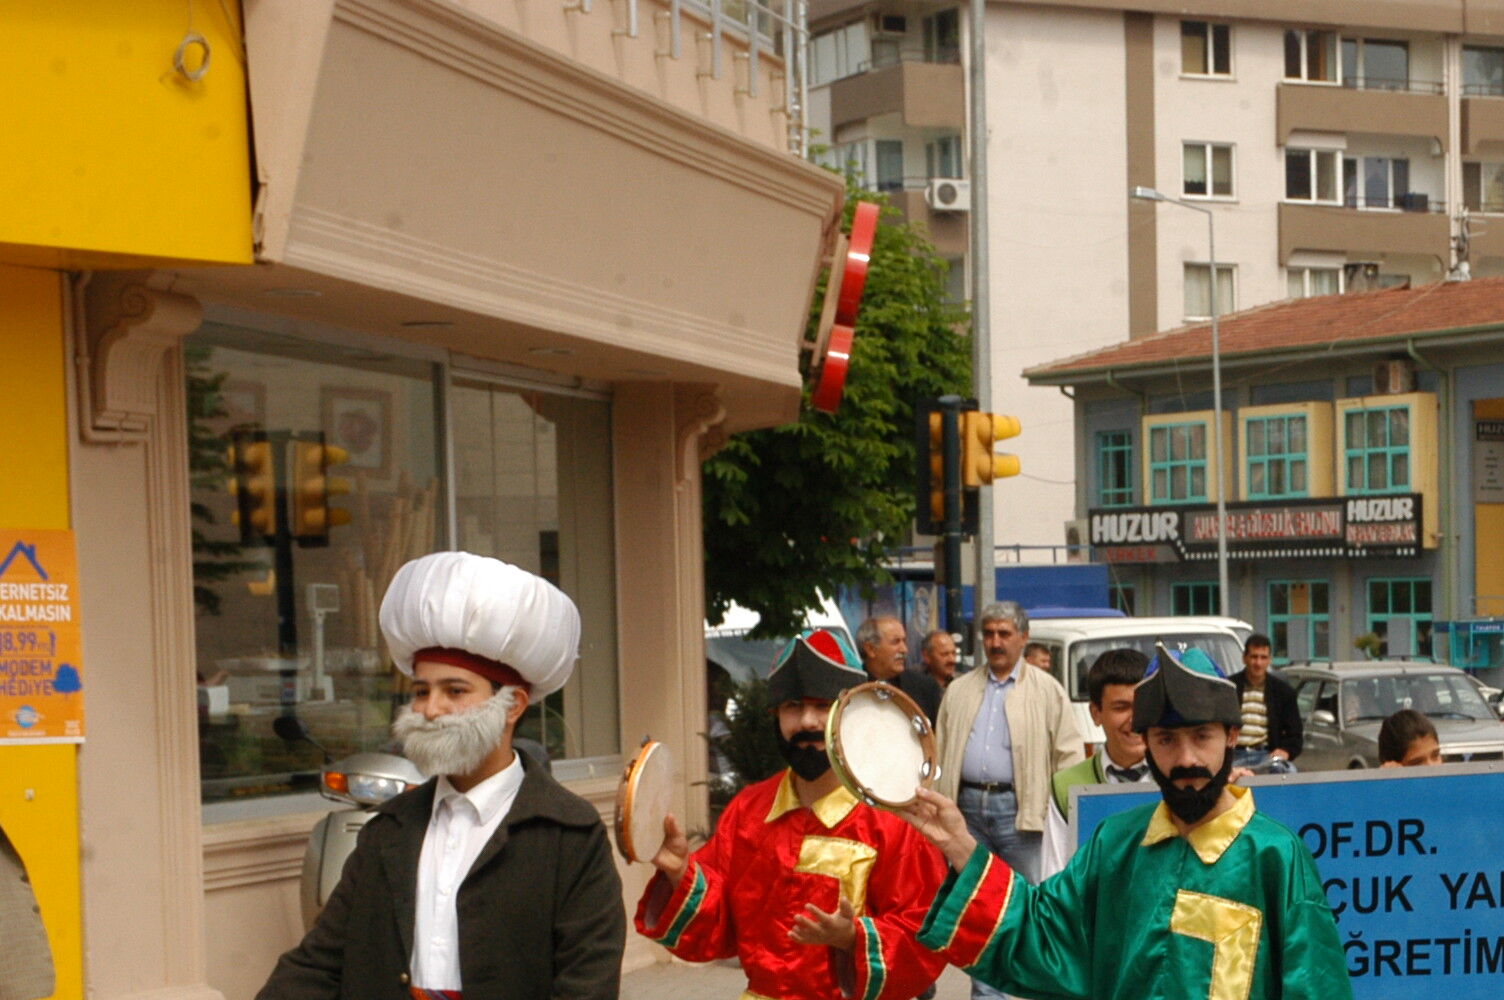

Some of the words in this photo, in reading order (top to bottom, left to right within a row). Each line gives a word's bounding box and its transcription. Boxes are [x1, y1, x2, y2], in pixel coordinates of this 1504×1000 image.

[1346, 497, 1414, 522] HUZUR
[1091, 511, 1179, 544] HUZUR
[0, 604, 71, 622] KALMASIN
